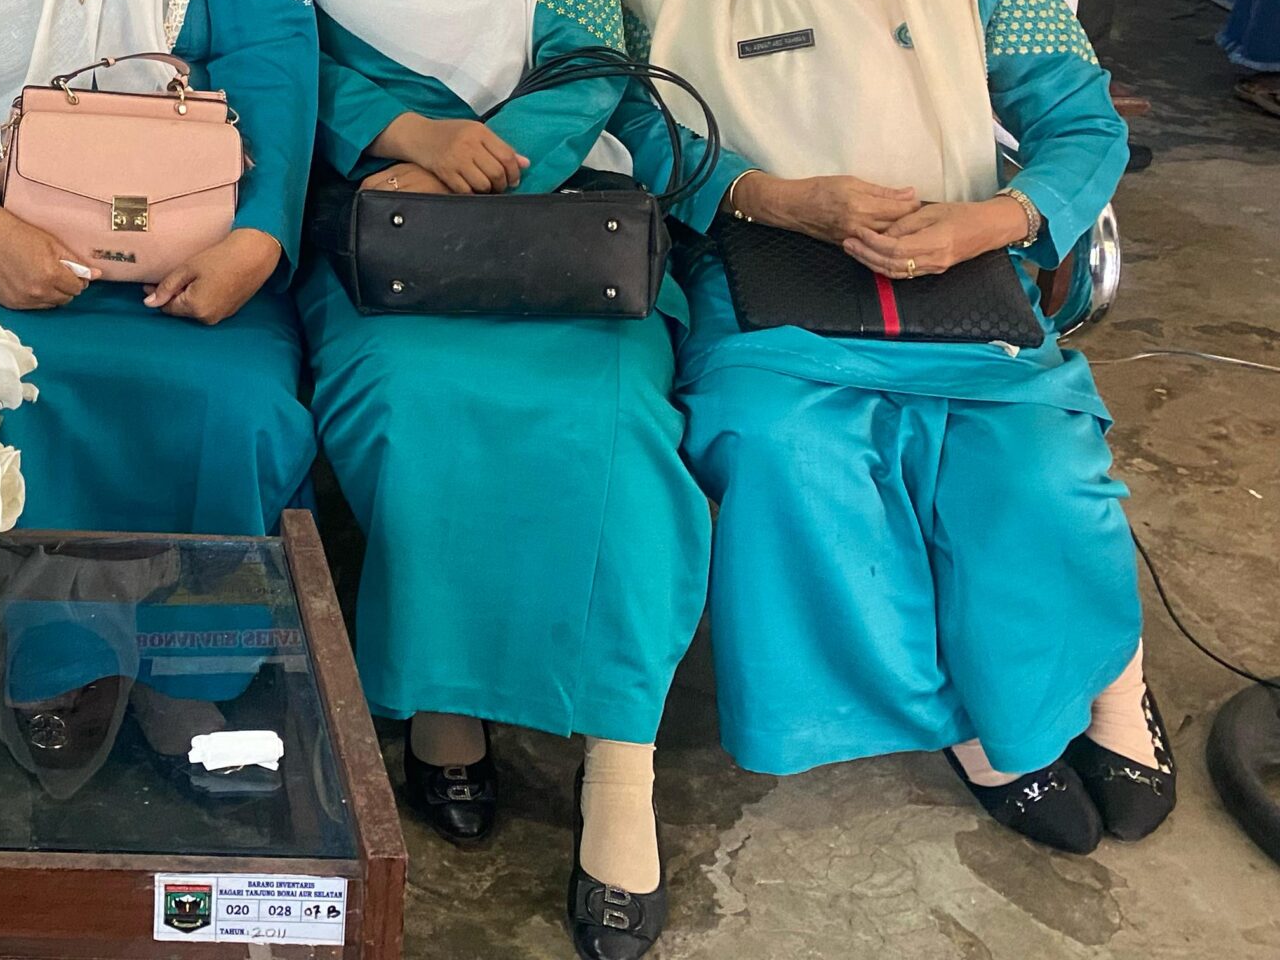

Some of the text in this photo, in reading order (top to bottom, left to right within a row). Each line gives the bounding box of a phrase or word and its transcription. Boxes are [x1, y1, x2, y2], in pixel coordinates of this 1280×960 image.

[248, 881, 274, 889] BARANG
[226, 904, 249, 915] 020
[268, 905, 292, 916] 028
